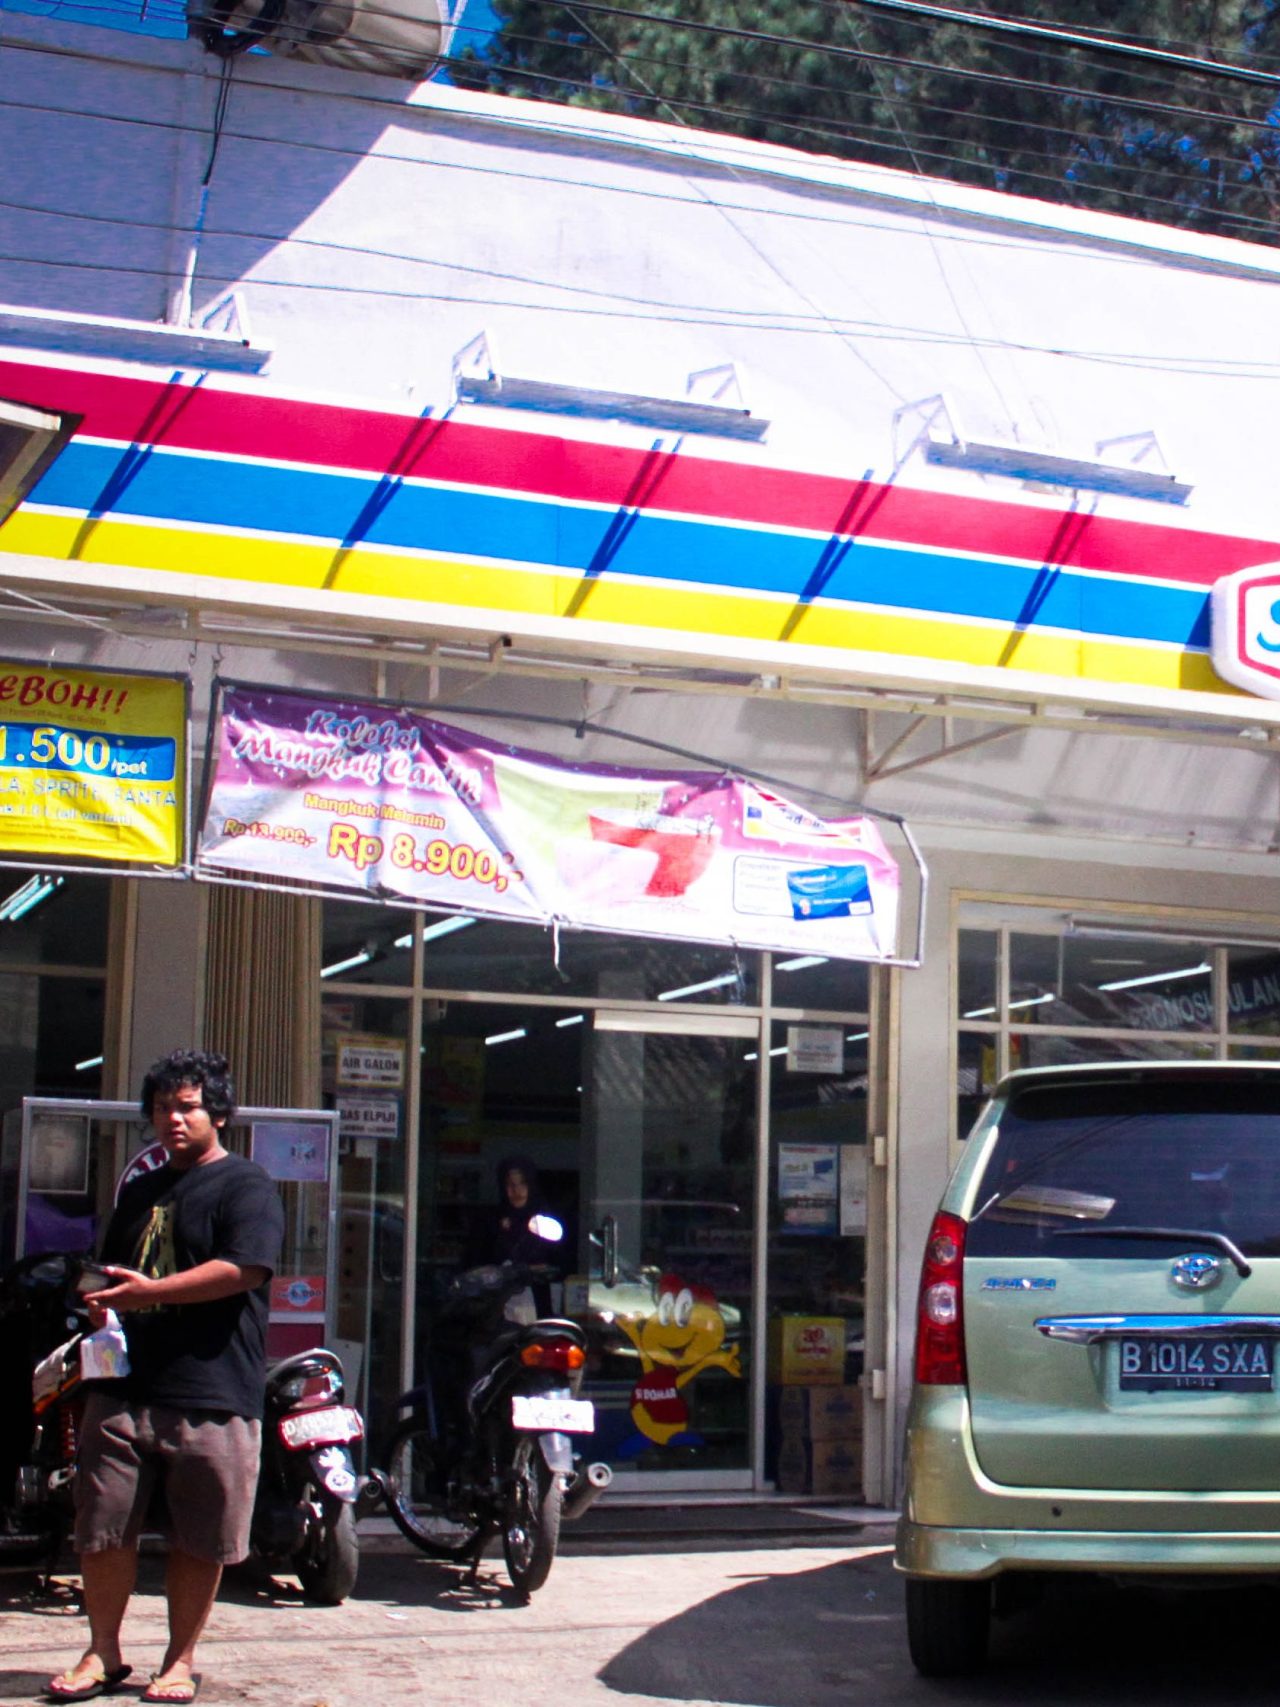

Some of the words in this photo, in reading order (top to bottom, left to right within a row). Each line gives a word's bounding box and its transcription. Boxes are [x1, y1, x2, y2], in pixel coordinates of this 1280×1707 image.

[304, 793, 377, 819] Mangkuk
[380, 804, 444, 829] Melamin
[328, 822, 382, 870] Rp
[342, 1057, 360, 1070] AIR
[364, 1058, 400, 1071] GALON
[1122, 1341, 1141, 1373] B
[1148, 1342, 1206, 1373] 1014
[1212, 1342, 1269, 1373] SXA
